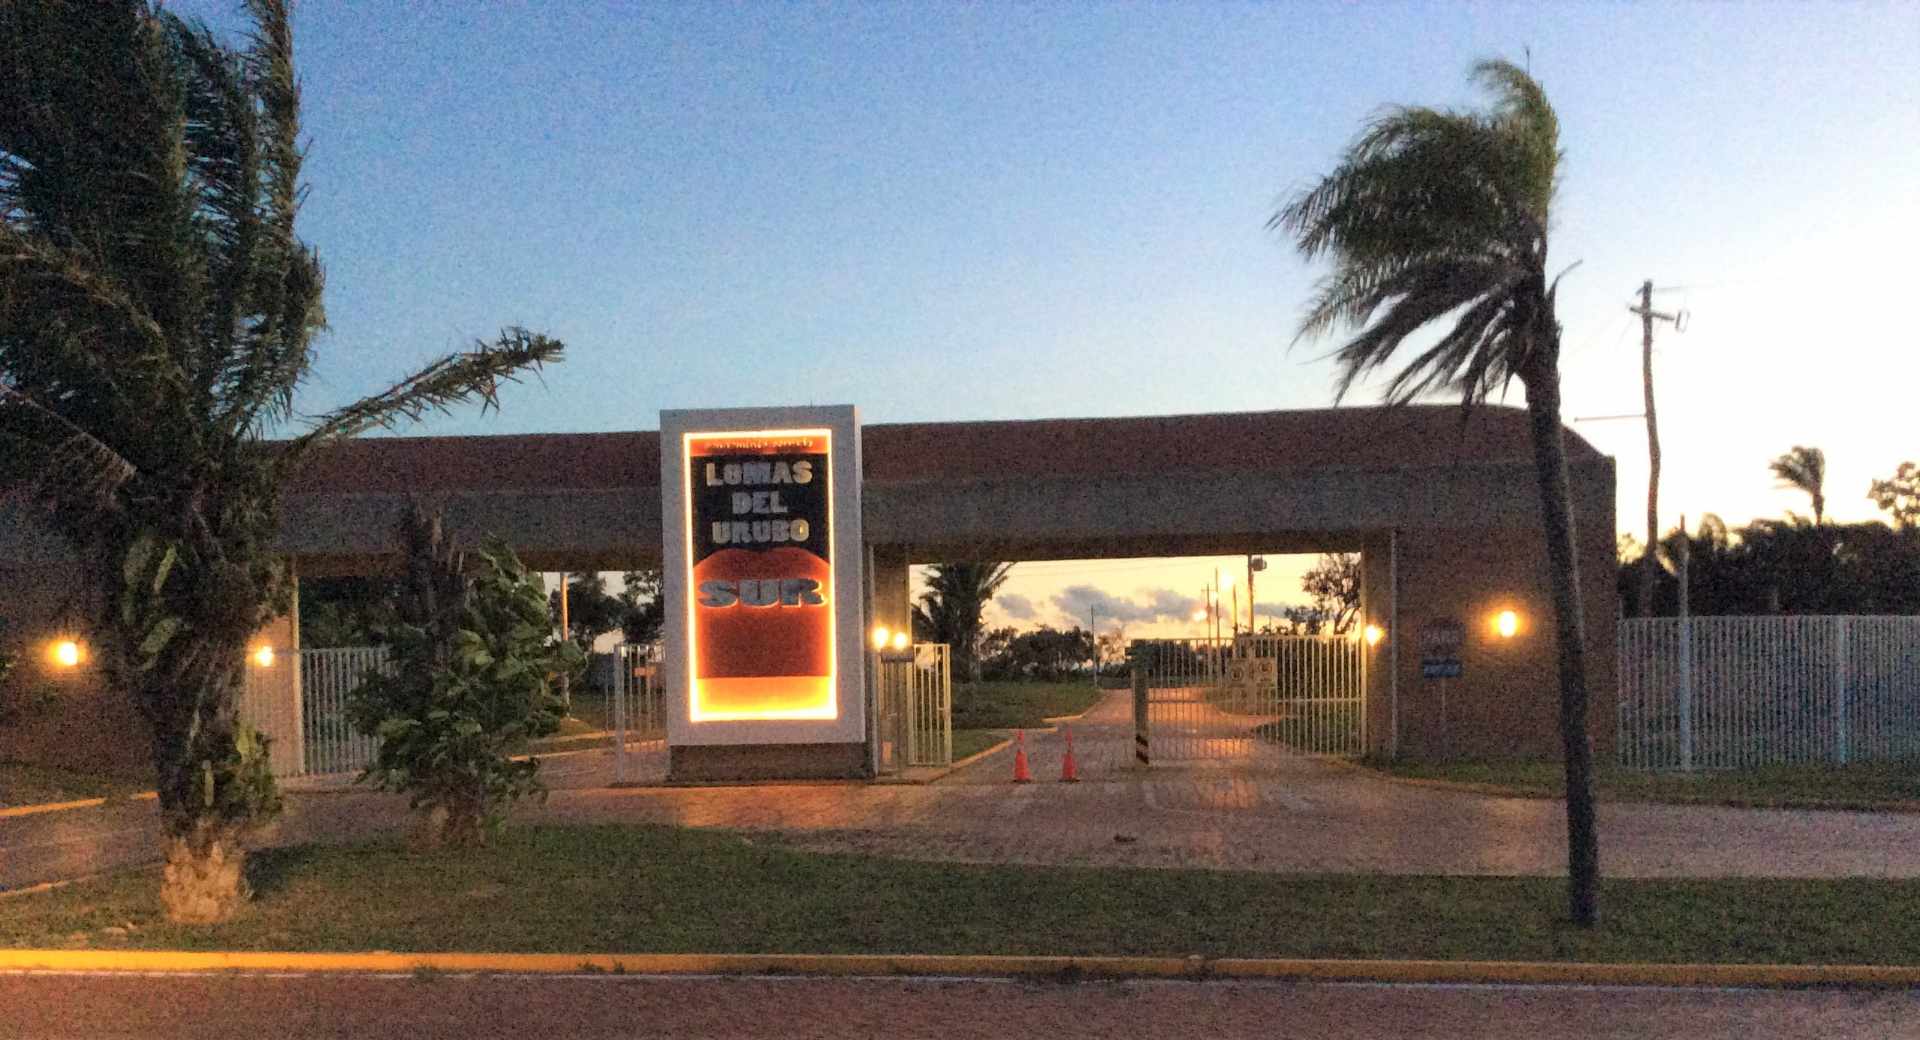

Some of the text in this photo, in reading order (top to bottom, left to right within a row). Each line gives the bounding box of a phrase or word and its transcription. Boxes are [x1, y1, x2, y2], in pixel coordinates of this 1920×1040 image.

[706, 461, 812, 486] LOMAS
[731, 491, 788, 514] DEL
[712, 519, 809, 544] URUBO
[698, 578, 827, 607] SUR
